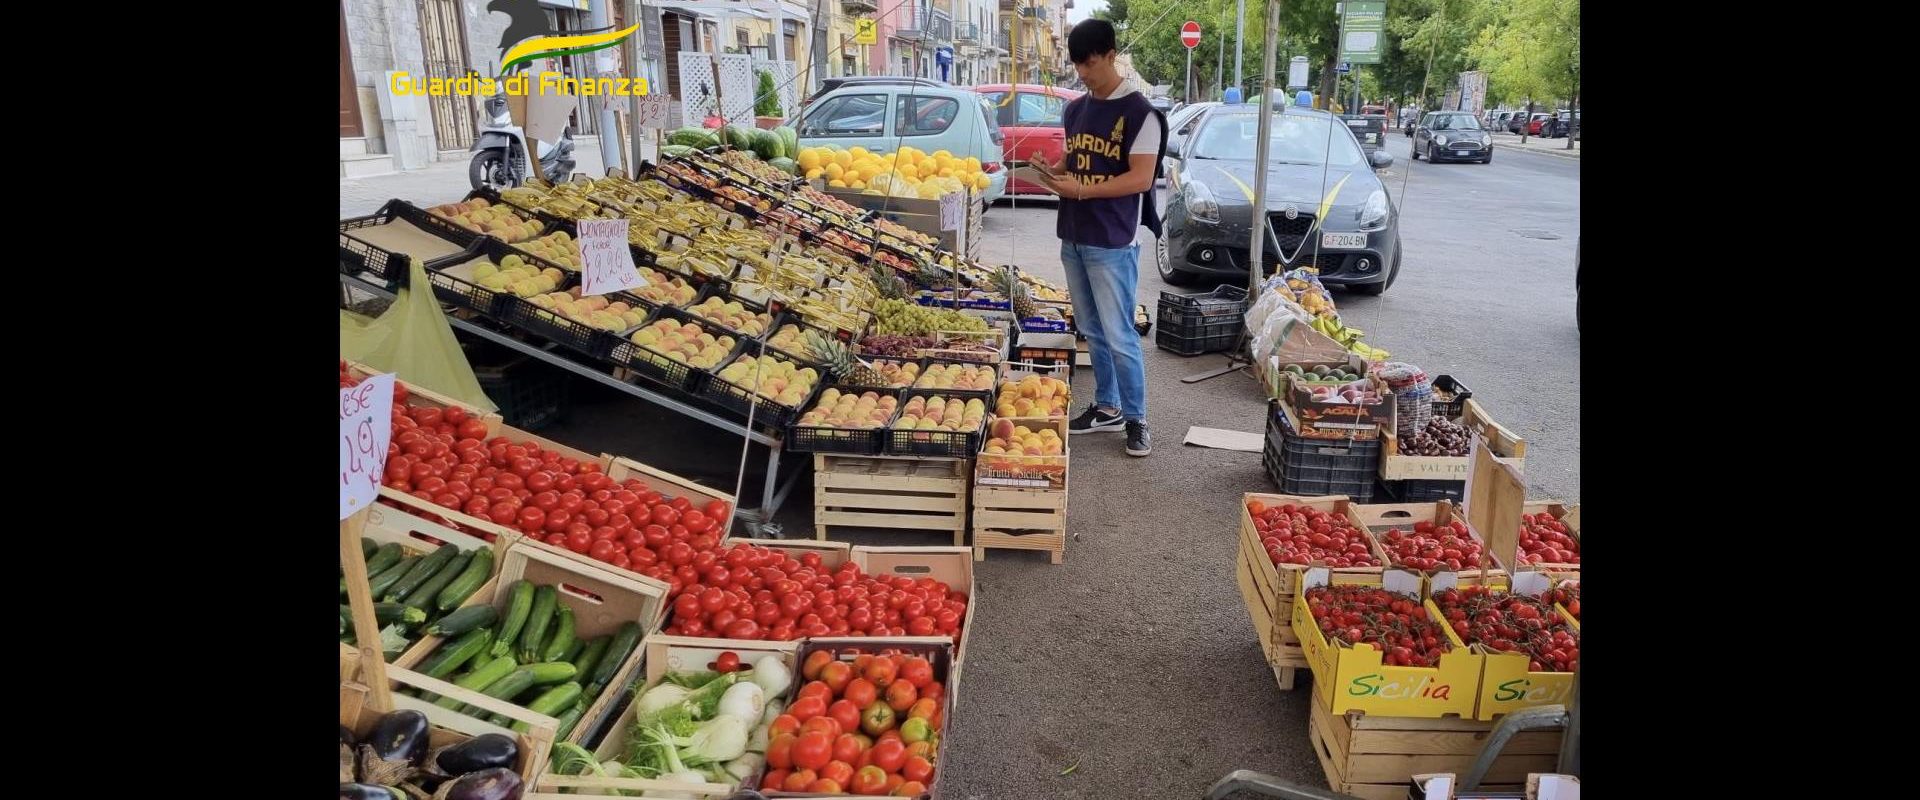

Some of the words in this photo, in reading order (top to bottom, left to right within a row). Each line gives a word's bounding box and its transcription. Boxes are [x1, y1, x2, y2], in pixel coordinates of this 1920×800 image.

[1077, 154, 1091, 170] DI
[1420, 463, 1440, 473] VAL
[1447, 463, 1468, 473] TRE
[1349, 674, 1450, 700] Sicilia
